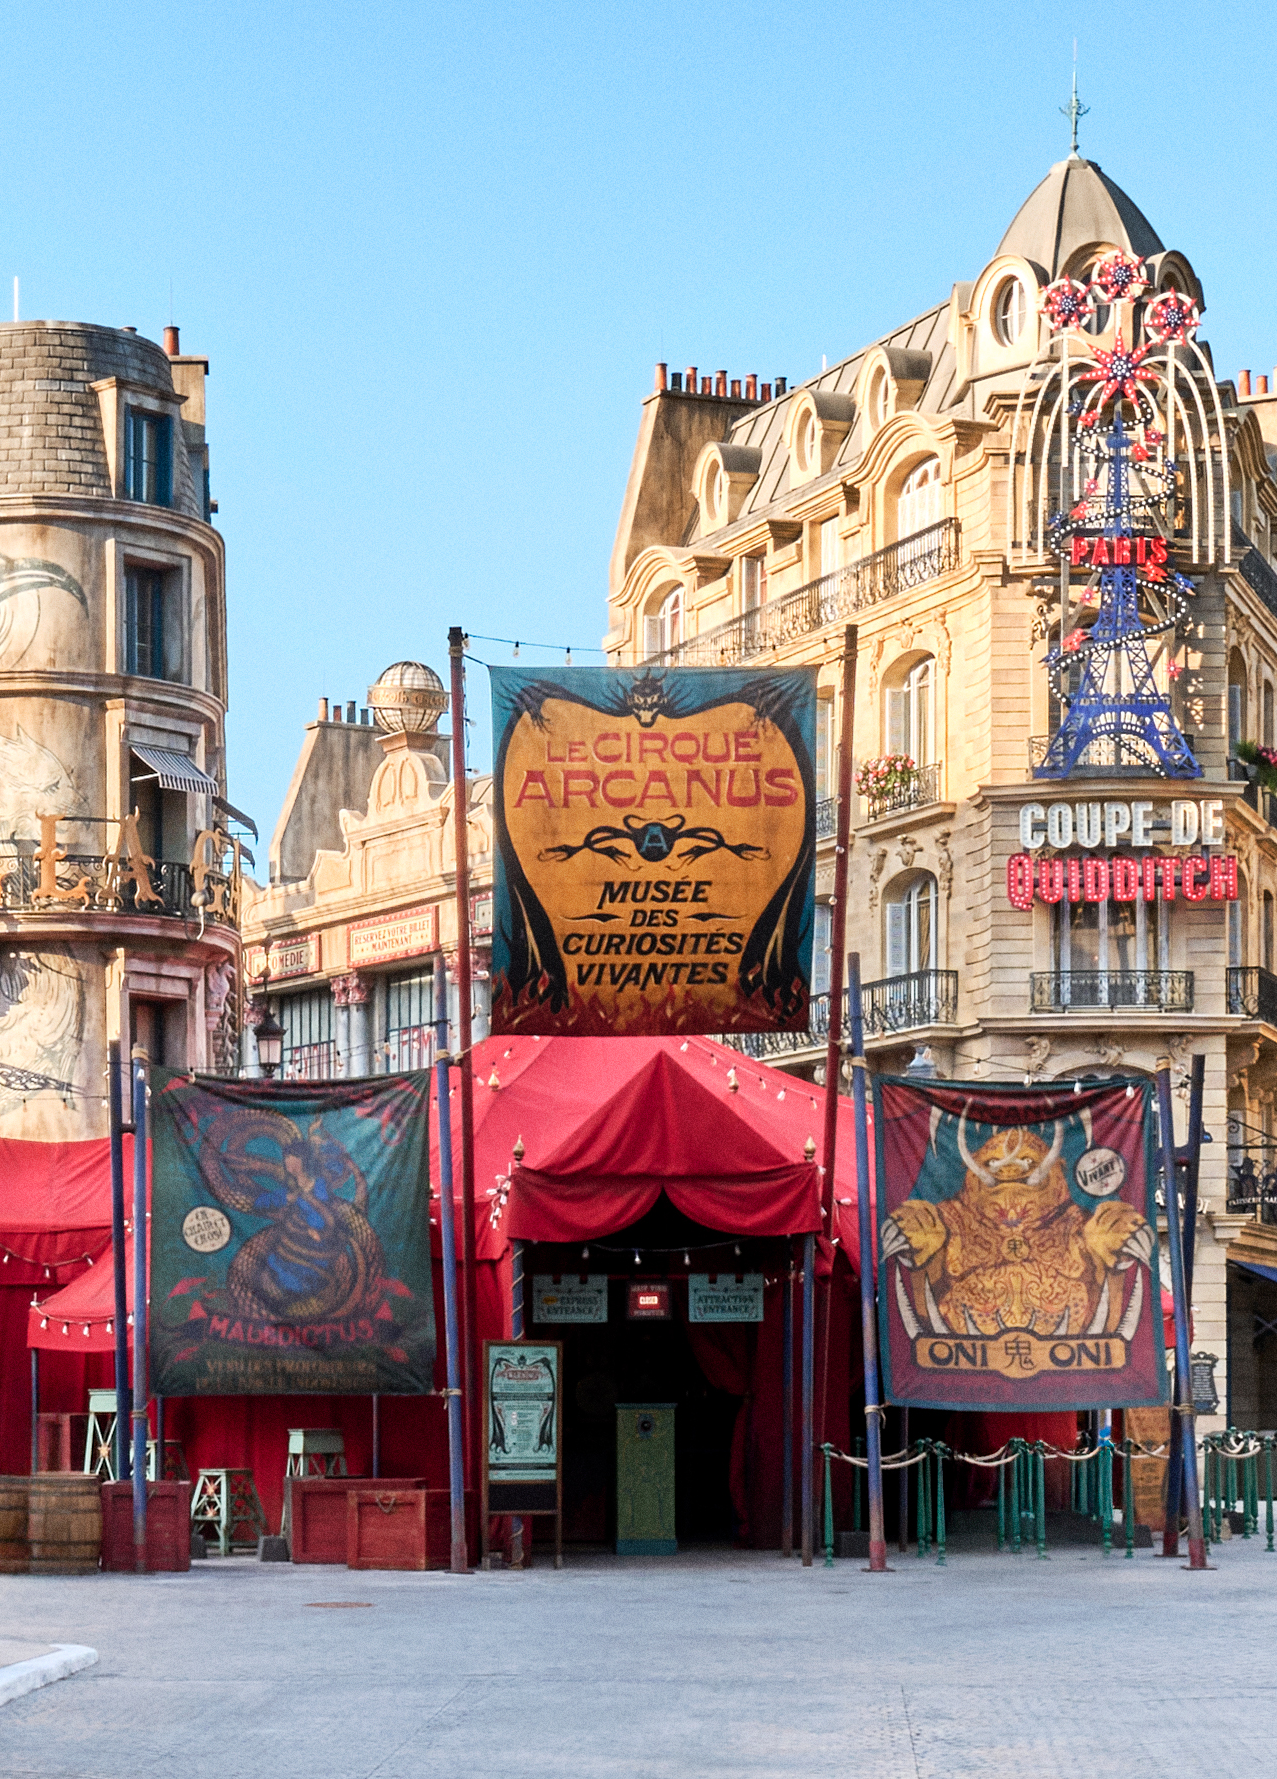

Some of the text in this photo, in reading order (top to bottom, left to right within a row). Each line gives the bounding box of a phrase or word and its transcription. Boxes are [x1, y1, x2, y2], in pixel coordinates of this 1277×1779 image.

[1072, 535, 1169, 566] PARIS
[546, 731, 763, 764] LE CIRQUE
[512, 767, 799, 809] ARCANUS
[1019, 800, 1224, 849] COUPE DE
[30, 805, 165, 909] LA
[597, 875, 712, 910] MUSÉE
[1007, 852, 1239, 912] QUIDDITCH
[629, 909, 679, 927] DES
[562, 927, 745, 956] CURIOSITÉS
[576, 962, 730, 991] VIVANTES
[208, 1315, 374, 1347] MALEDICTUS
[928, 1341, 988, 1367] ONI
[1004, 1335, 1038, 1371] 鬼
[1049, 1341, 1112, 1368] ONI
